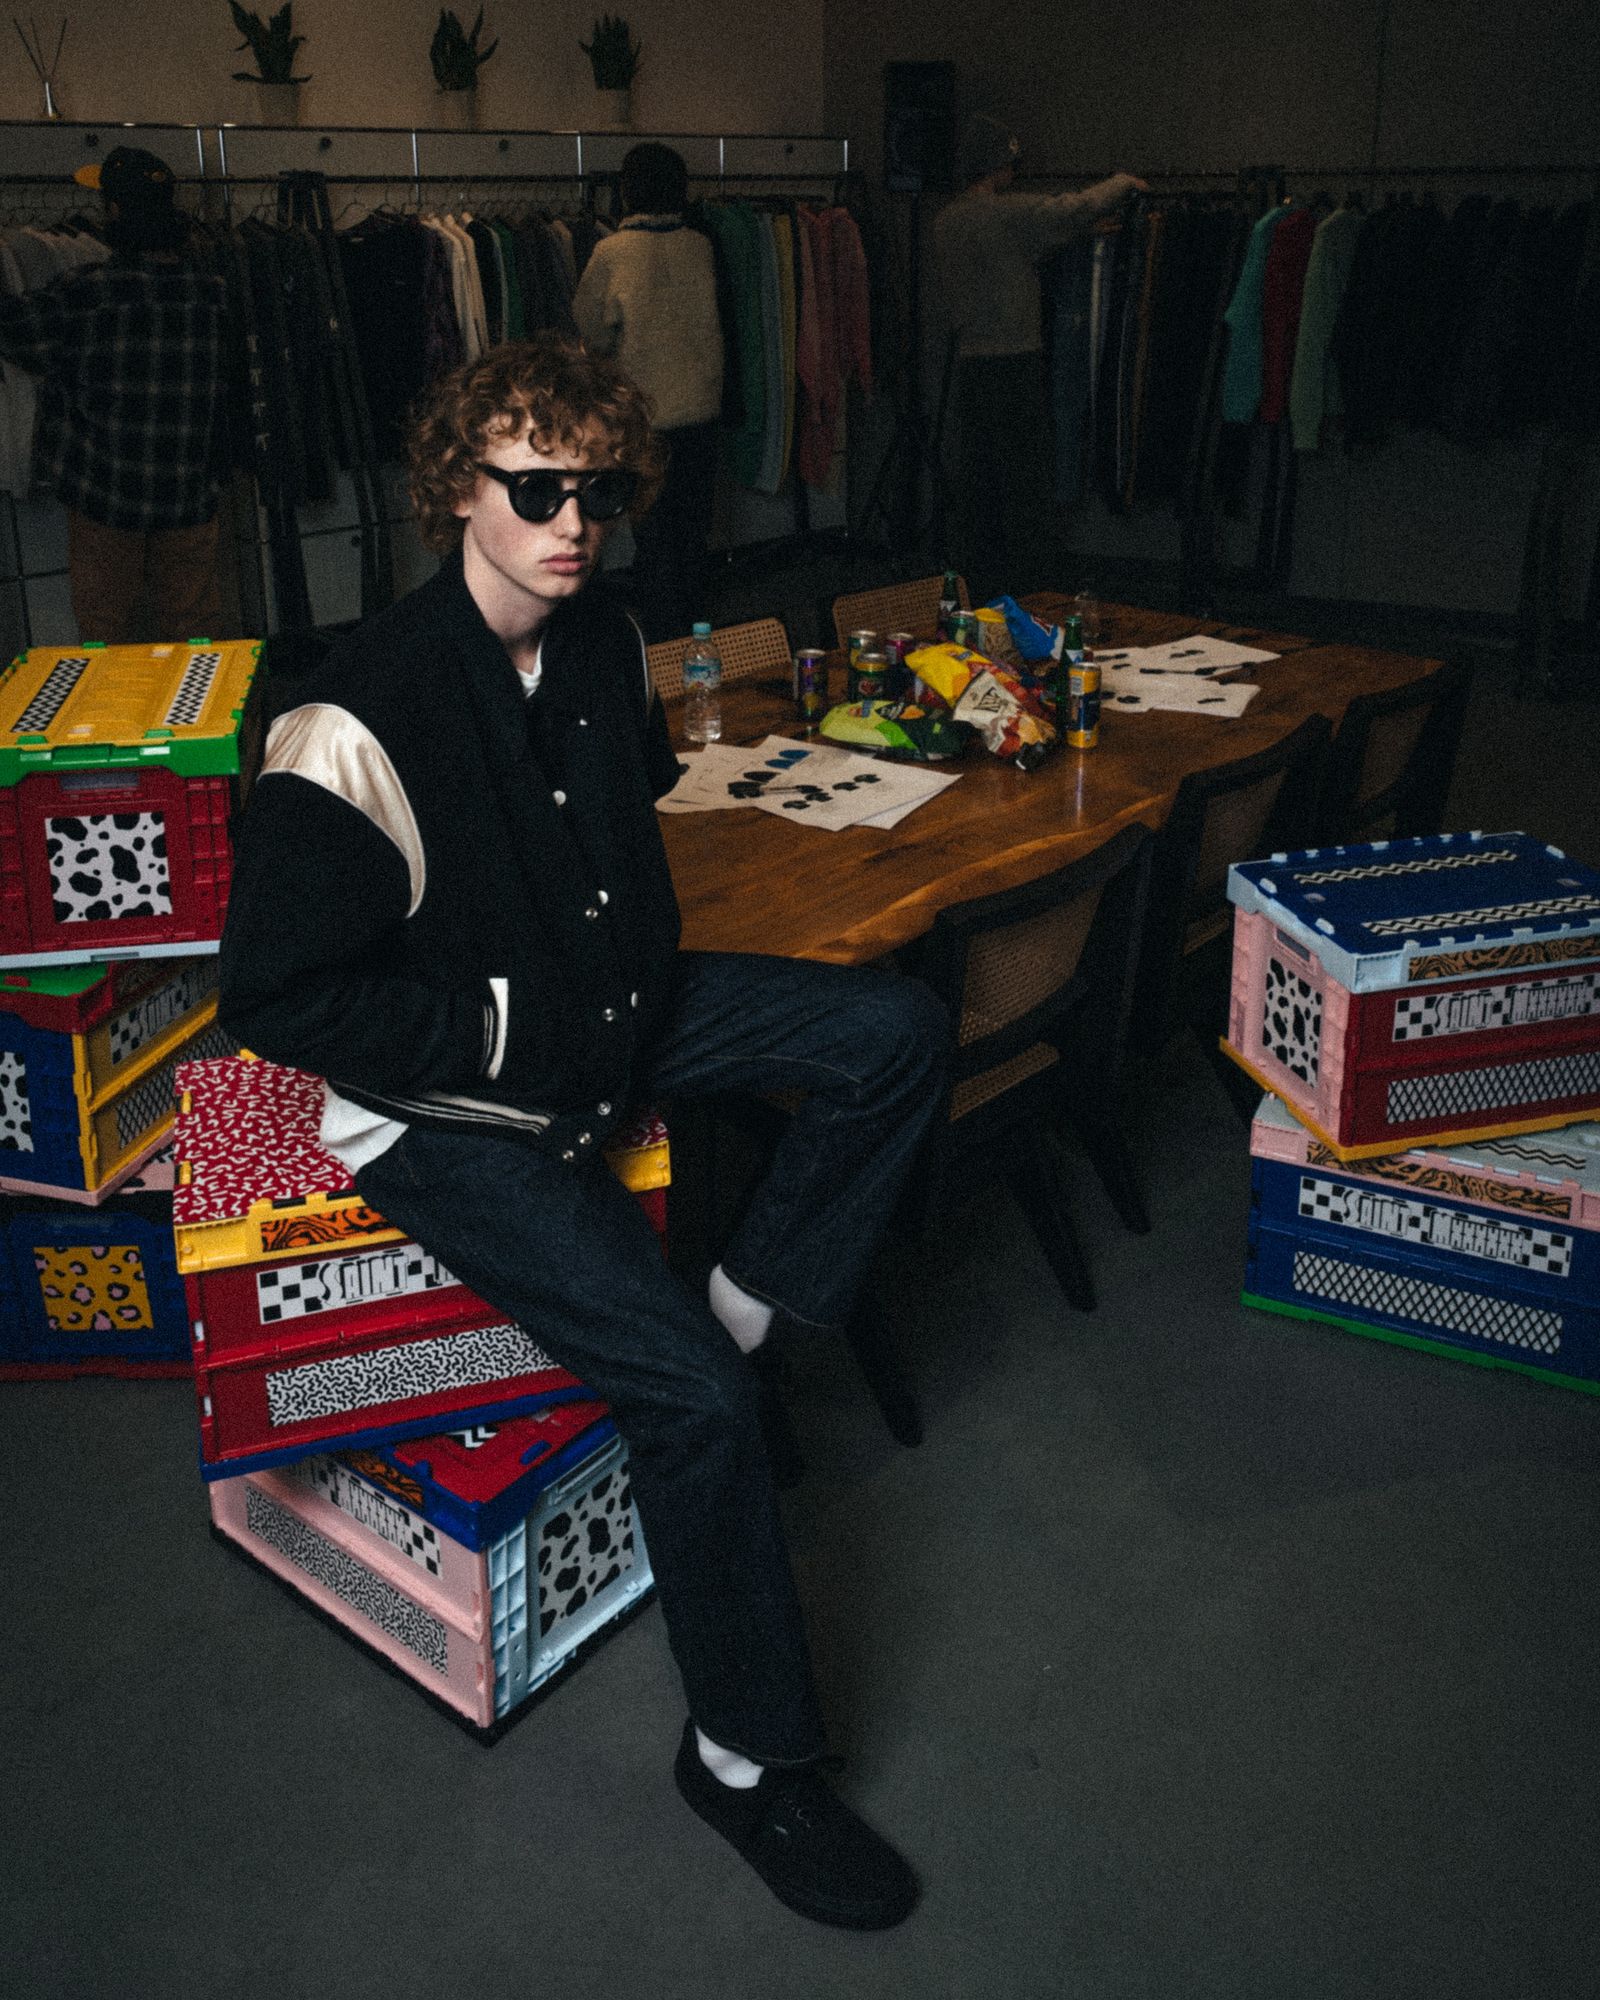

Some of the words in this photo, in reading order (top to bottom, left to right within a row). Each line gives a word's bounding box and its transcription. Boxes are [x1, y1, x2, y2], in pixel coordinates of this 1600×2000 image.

[1434, 992, 1494, 1035] SAINT
[1341, 1188, 1411, 1236] SAINT
[318, 1254, 410, 1307] SAINT
